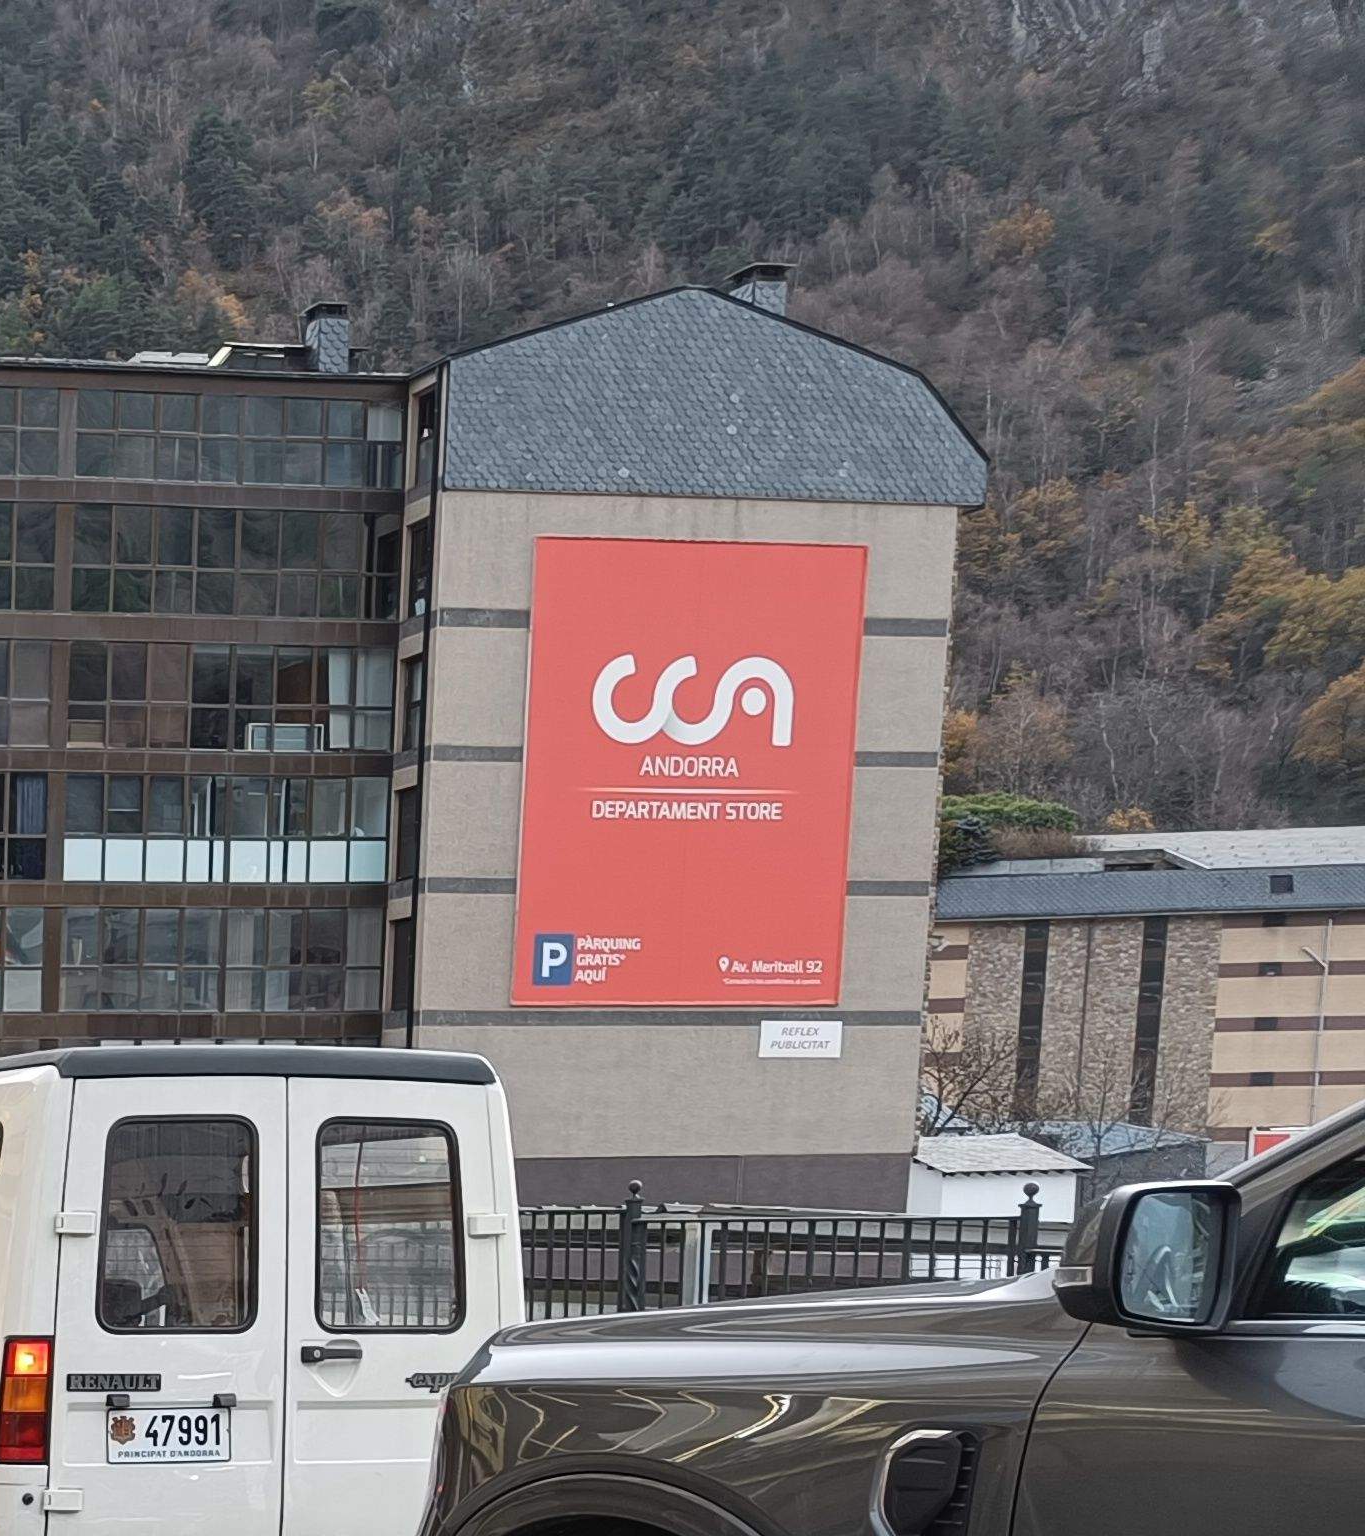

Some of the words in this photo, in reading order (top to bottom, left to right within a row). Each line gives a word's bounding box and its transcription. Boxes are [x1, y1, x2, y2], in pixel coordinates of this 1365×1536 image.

[639, 756, 739, 777] ANDORRA
[592, 800, 721, 819] DEPARTAMENT
[725, 802, 783, 819] STORE
[577, 935, 641, 952] PÀRQUING
[541, 942, 568, 978] P
[731, 961, 749, 973] Av.
[752, 960, 803, 973] Meritxell
[806, 961, 823, 973] 92
[574, 967, 607, 984] AQUÍ
[781, 1027, 820, 1036] REFLEX
[770, 1041, 830, 1049] PUBLICITAT
[69, 1375, 160, 1390] RENAULT
[145, 1413, 221, 1446] 47991
[118, 1450, 167, 1458] PRINCIPAT
[170, 1450, 221, 1458] D'ANDORRA
